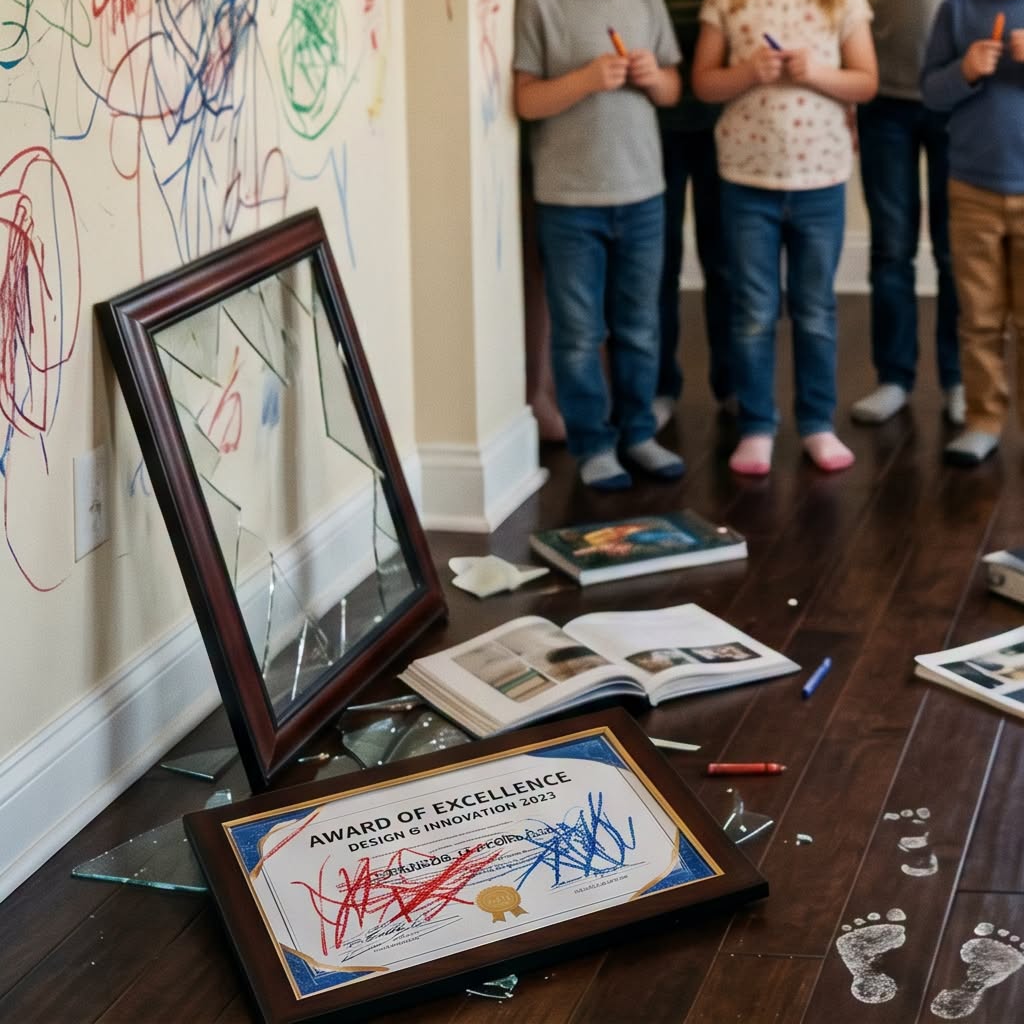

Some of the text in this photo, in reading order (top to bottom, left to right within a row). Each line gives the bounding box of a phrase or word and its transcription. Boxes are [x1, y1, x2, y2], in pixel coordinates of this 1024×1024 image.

[310, 770, 572, 847] AWARD OF EXCELLENCE
[347, 830, 406, 853] DESIGN
[424, 801, 518, 832] INNOVATION
[520, 790, 557, 809] 2023
